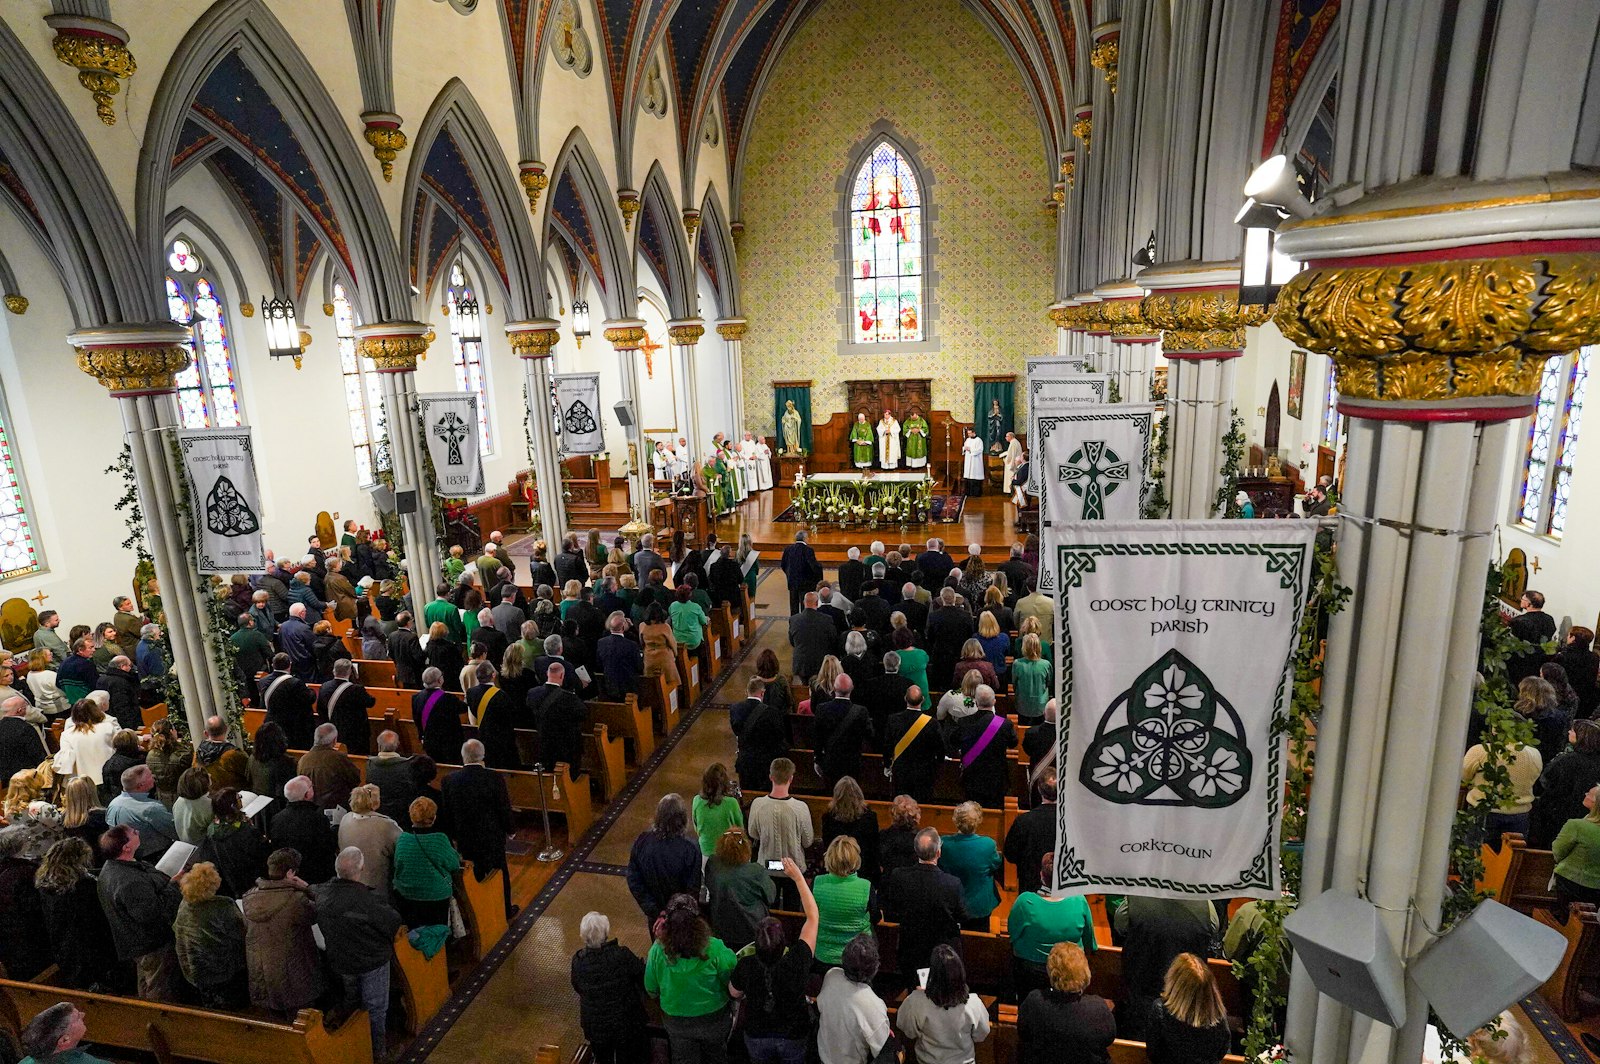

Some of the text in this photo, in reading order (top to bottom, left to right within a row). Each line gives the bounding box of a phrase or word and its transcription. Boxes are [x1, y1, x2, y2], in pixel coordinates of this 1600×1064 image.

[446, 476, 469, 485] 1834
[1090, 595, 1275, 617] MOST HOLY TRINITY
[1150, 618, 1208, 636] PARISH
[1120, 838, 1212, 858] CORKTOWN
